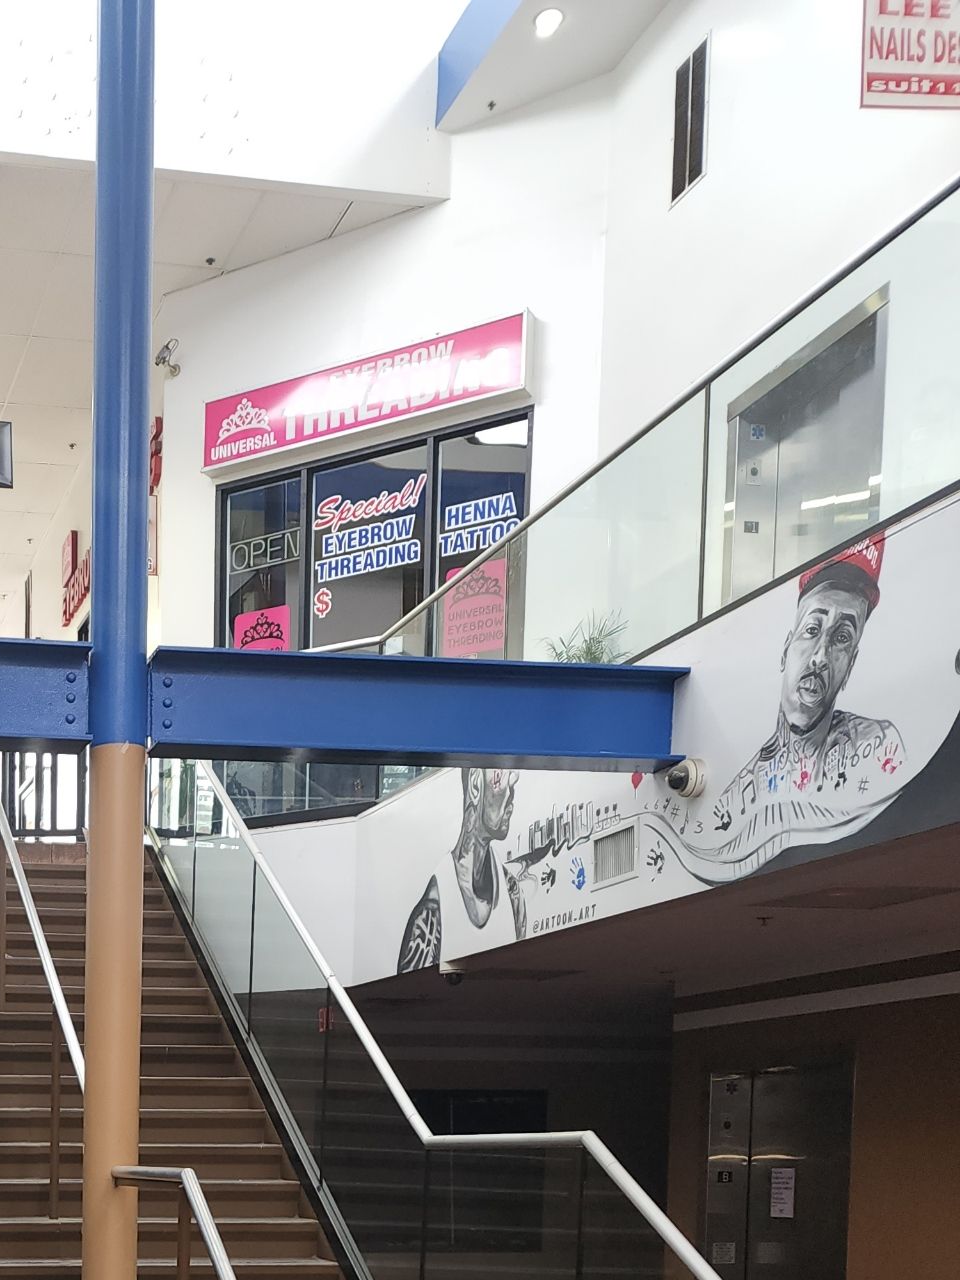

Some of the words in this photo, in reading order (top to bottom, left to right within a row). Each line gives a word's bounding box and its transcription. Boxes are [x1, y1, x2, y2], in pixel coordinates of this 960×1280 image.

[869, 25, 927, 63] NAILS
[933, 29, 960, 64] DE
[330, 339, 456, 380] BROW
[210, 432, 278, 461] UNIVERSAL
[314, 474, 427, 532] Special!
[445, 493, 517, 530] HENNA
[231, 530, 300, 570] OPEN
[323, 514, 416, 557] EYEBROW
[316, 540, 421, 582] THREADING
[62, 547, 90, 627] EYEBRO
[447, 616, 504, 635] EYEBROW
[448, 604, 504, 622] UNIVERSAL
[448, 630, 504, 649] THREADING
